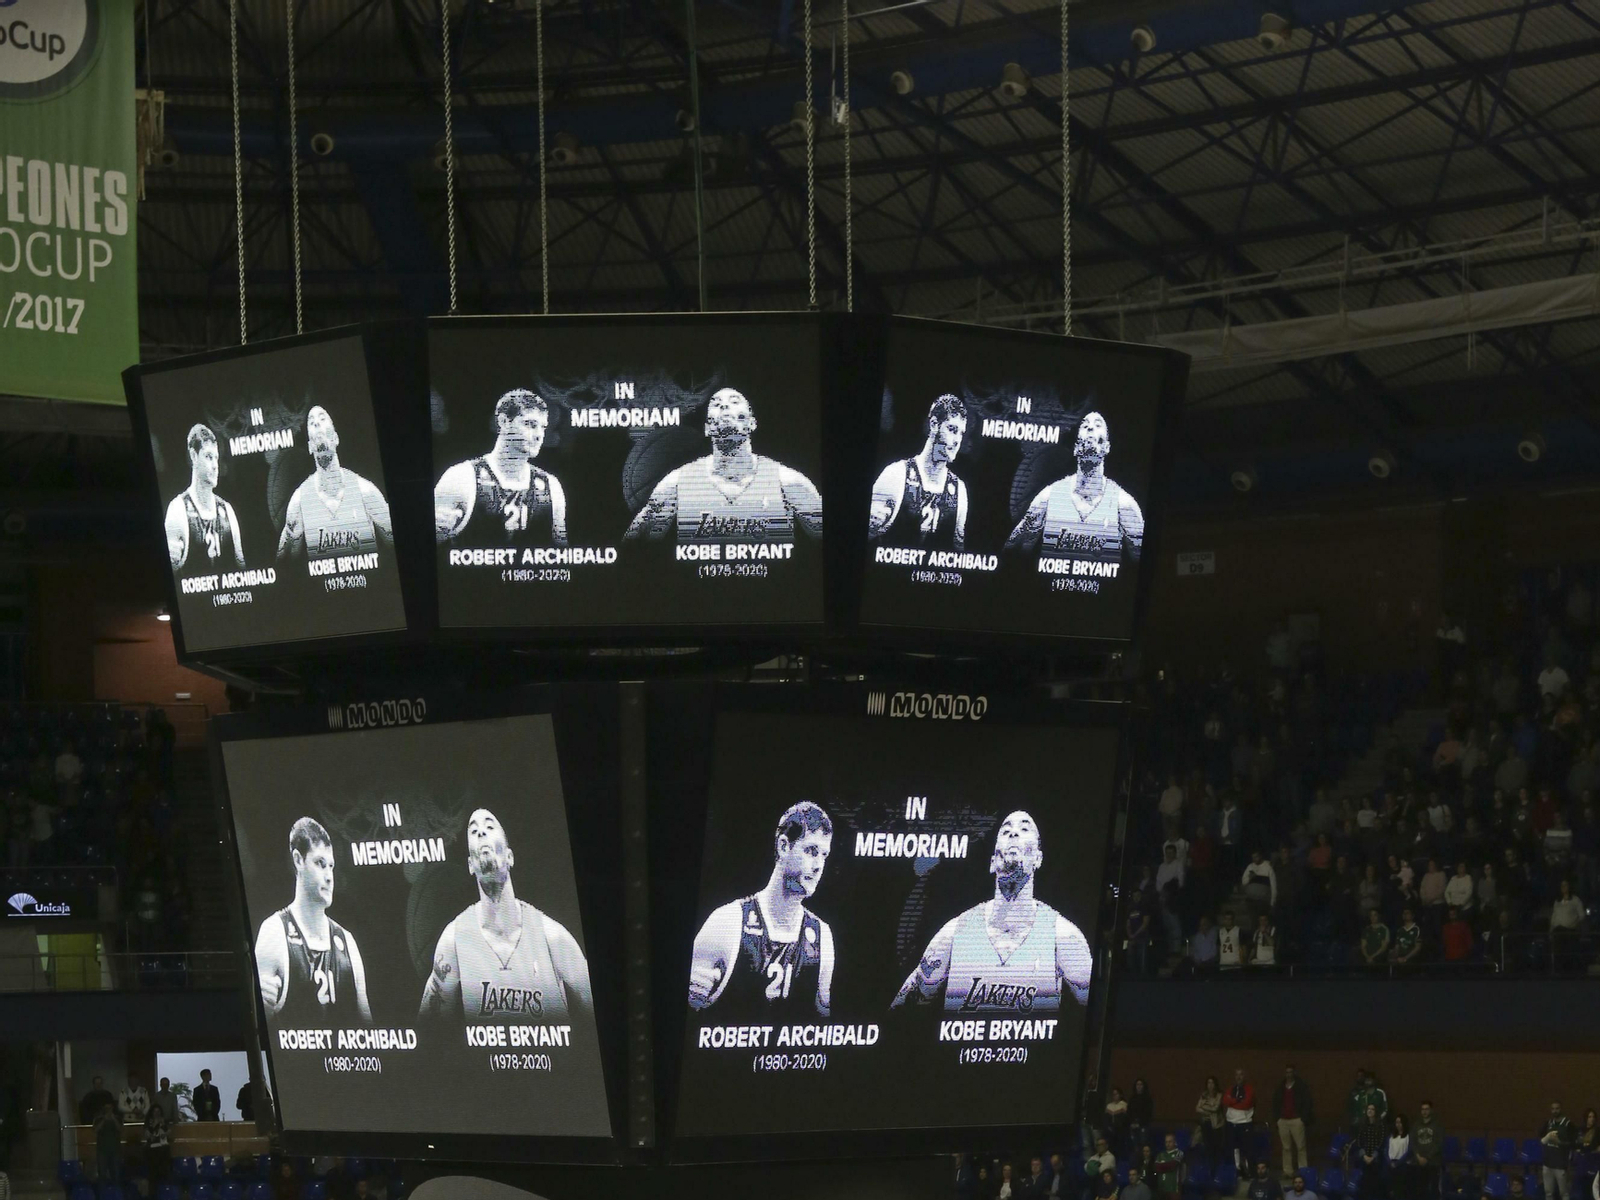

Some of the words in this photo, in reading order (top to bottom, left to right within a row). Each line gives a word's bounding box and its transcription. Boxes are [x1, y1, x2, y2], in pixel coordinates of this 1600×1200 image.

[0, 155, 128, 236] EONES
[615, 382, 634, 400] IN
[250, 407, 264, 426] IN
[571, 407, 680, 428] MEMORIAM
[1017, 396, 1032, 414] IN
[229, 429, 294, 456] MEMORIAM
[982, 419, 1060, 444] MEMORIAM
[504, 505, 528, 530] 21
[920, 506, 940, 533] 21
[317, 528, 360, 552] LAKERS
[676, 543, 721, 561] KOBE
[725, 542, 794, 560] BRYANT
[308, 558, 336, 577] KOBE
[337, 553, 379, 574] BRYANT
[450, 547, 516, 565] ROBERT
[522, 547, 617, 564] ARCHIBALD
[875, 546, 926, 567] ROBERT
[928, 550, 998, 572] ARCHIBALD
[1038, 557, 1071, 575] KOBE
[1072, 559, 1120, 578] BRYANT
[181, 574, 219, 594] ROBERT
[221, 568, 277, 590] ARCHIBALD
[347, 698, 426, 729] MONDO
[890, 692, 988, 720] MONDO
[383, 803, 402, 828] IN
[905, 796, 927, 821] IN
[351, 837, 446, 867] MEMORIAM
[854, 832, 969, 859] MEMORIAM
[35, 902, 70, 914] Unicaja
[314, 973, 336, 1005] 21
[765, 963, 793, 1000] 21
[478, 981, 544, 1018] LAKERS
[958, 977, 1038, 1014] LAKERS
[278, 1029, 333, 1050] ROBERT
[337, 1028, 417, 1050] ARCHIBALD
[466, 1025, 507, 1047] KOBE
[509, 1025, 571, 1046] BRYANT
[698, 1025, 773, 1049] ROBERT
[777, 1023, 880, 1047] ARCHIBALD
[939, 1021, 985, 1042] KOBE
[989, 1019, 1058, 1041] BRYANT
[324, 1056, 382, 1073] (1980-2020)
[489, 1054, 551, 1072] (1978-2020)
[753, 1053, 827, 1073] (1980-2020)
[959, 1047, 1028, 1064] (1978-2020)
